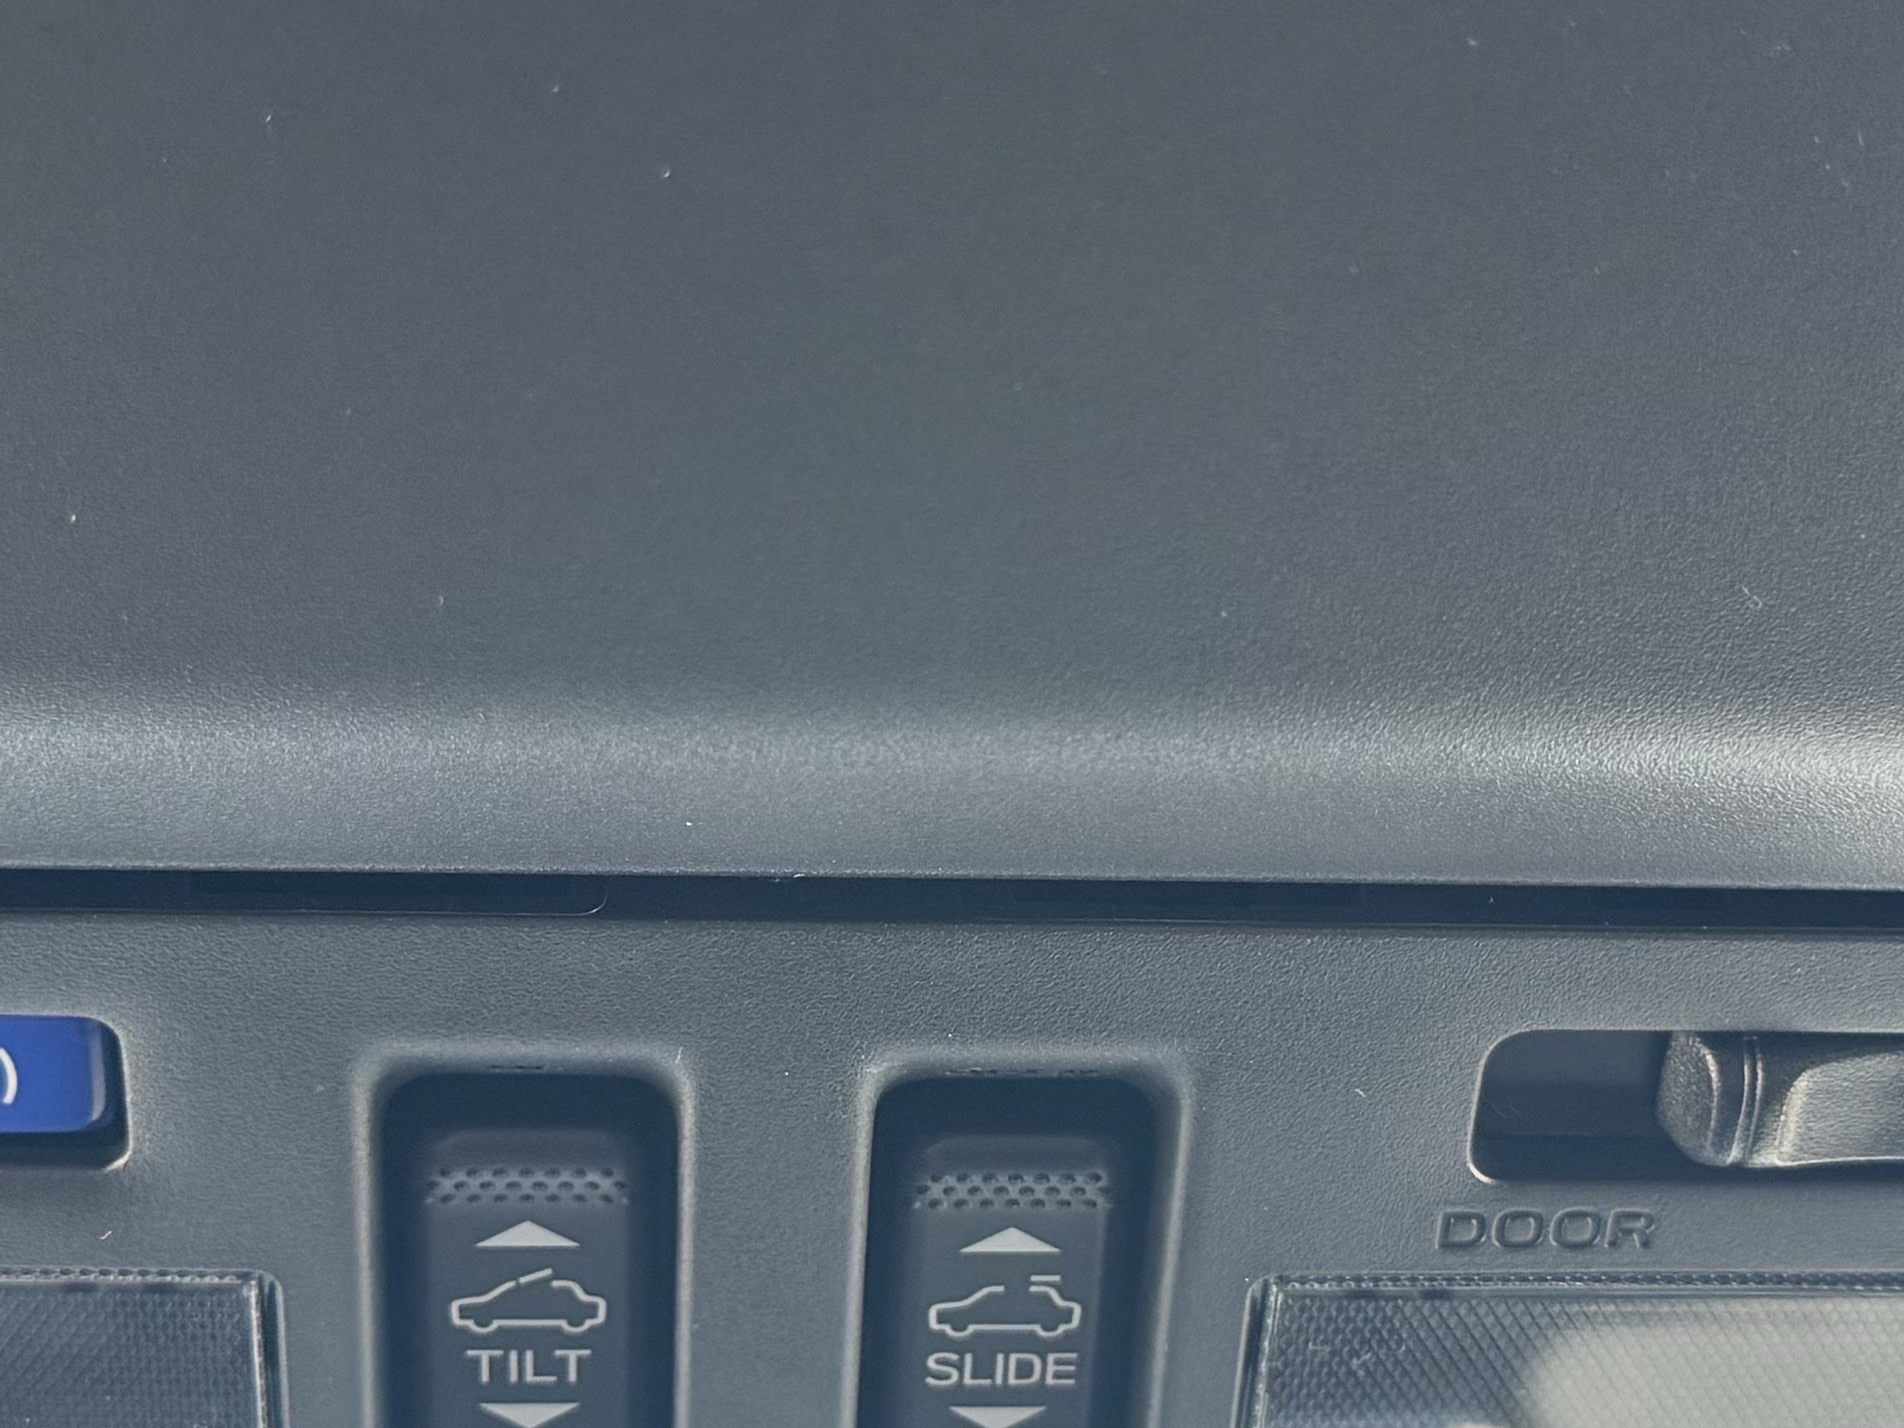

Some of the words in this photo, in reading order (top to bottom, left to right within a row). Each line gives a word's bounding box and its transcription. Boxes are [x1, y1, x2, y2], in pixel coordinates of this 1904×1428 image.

[1434, 1209, 1659, 1253] DOOR
[467, 1350, 592, 1384] TILT
[925, 1352, 1078, 1386] SLIDE
